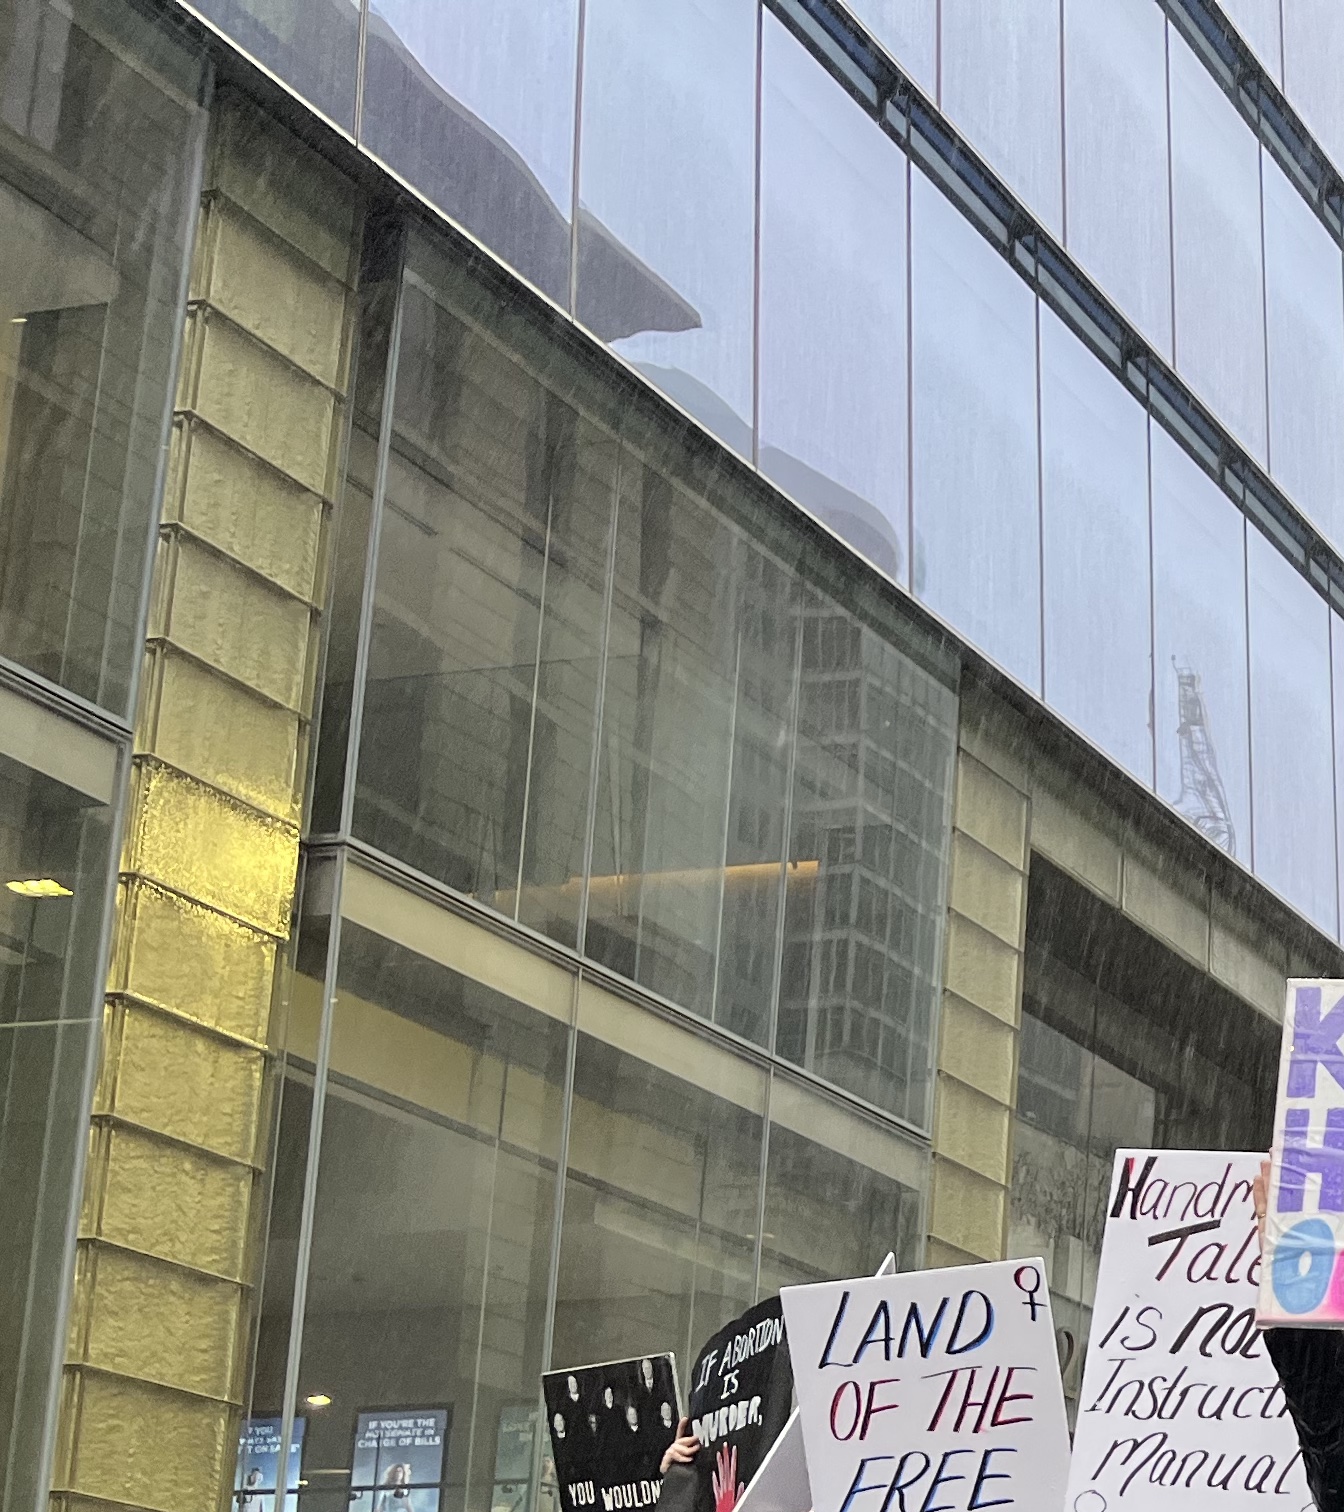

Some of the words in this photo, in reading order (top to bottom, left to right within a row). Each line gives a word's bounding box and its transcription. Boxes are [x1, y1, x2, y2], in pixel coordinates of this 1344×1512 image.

[695, 1353, 719, 1393] IF
[717, 1313, 786, 1378] ABORTION
[818, 1289, 996, 1370] LAND
[720, 1371, 740, 1400] IS
[829, 1378, 901, 1443] OF
[920, 1365, 1038, 1435] THE
[568, 1480, 595, 1507] YOU
